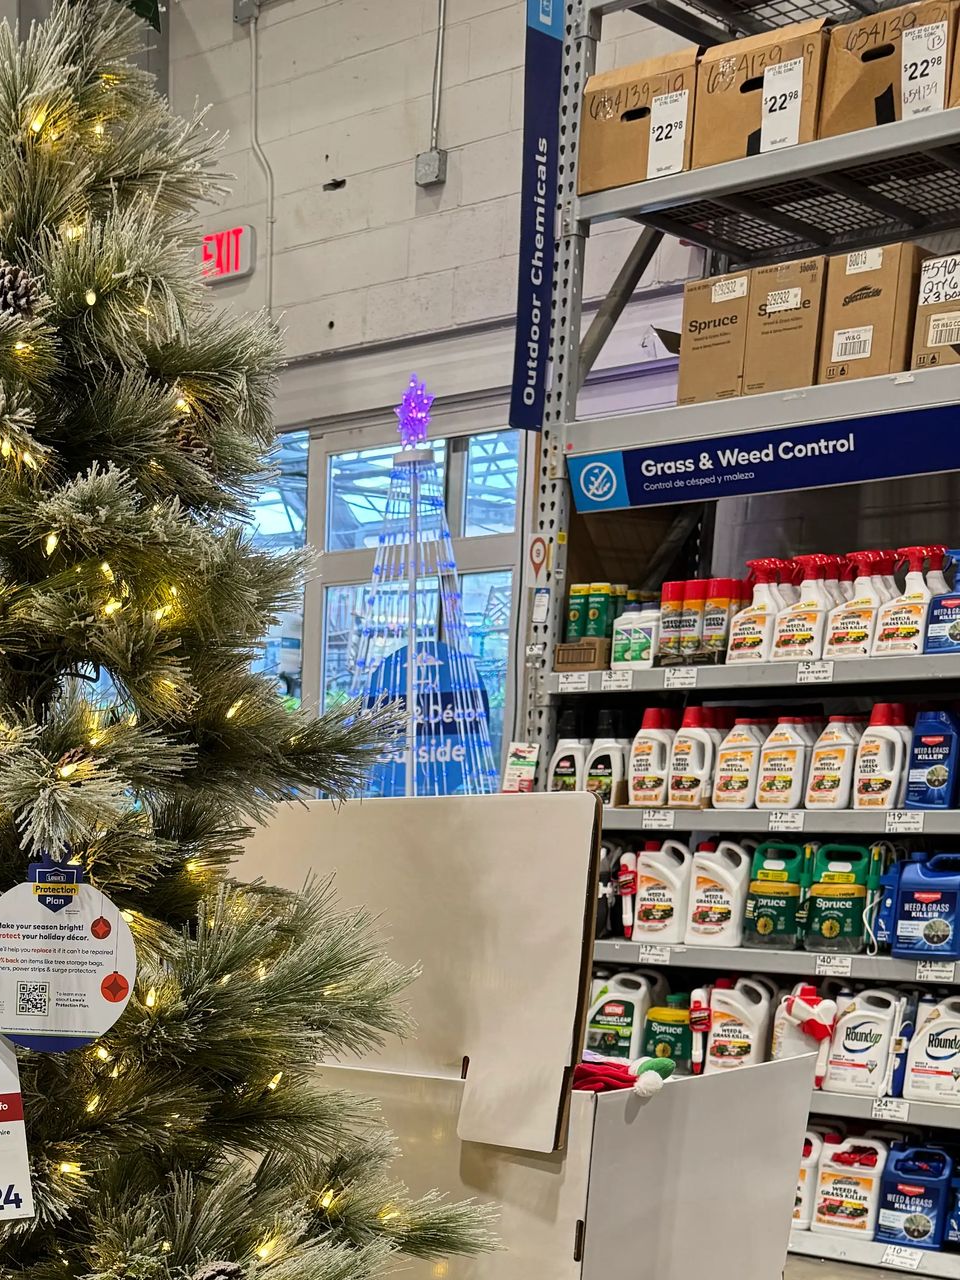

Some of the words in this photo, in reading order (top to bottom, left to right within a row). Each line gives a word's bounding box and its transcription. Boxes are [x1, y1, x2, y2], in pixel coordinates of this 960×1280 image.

[531, 136, 547, 286] Chemicals
[202, 227, 243, 277] EXIT
[933, 291, 940, 302] 3
[689, 314, 738, 335] Spruce
[523, 293, 543, 406] Outdoor
[641, 457, 695, 477] Grass
[698, 453, 714, 471] &
[716, 446, 774, 467] Weed
[778, 433, 855, 461] Control
[643, 480, 673, 491] Control
[674, 479, 685, 487] de
[686, 475, 716, 487] césped
[723, 472, 755, 481] maleza
[35, 886, 76, 894] Protection
[46, 897, 64, 905] Plan
[816, 898, 853, 910] Spruce
[927, 904, 949, 912] GRASS
[59, 924, 83, 932] bright!
[67, 933, 89, 941] décor.
[595, 1015, 632, 1023] GROUNDCLEAR
[651, 1022, 682, 1034] Spruce
[845, 1026, 882, 1046] Roundup
[821, 1190, 843, 1198] GRASS
[844, 1193, 867, 1201] KILLER
[832, 1186, 852, 1194] WEED
[894, 1203, 922, 1211] KILLER
[909, 1197, 932, 1208] GRASS
